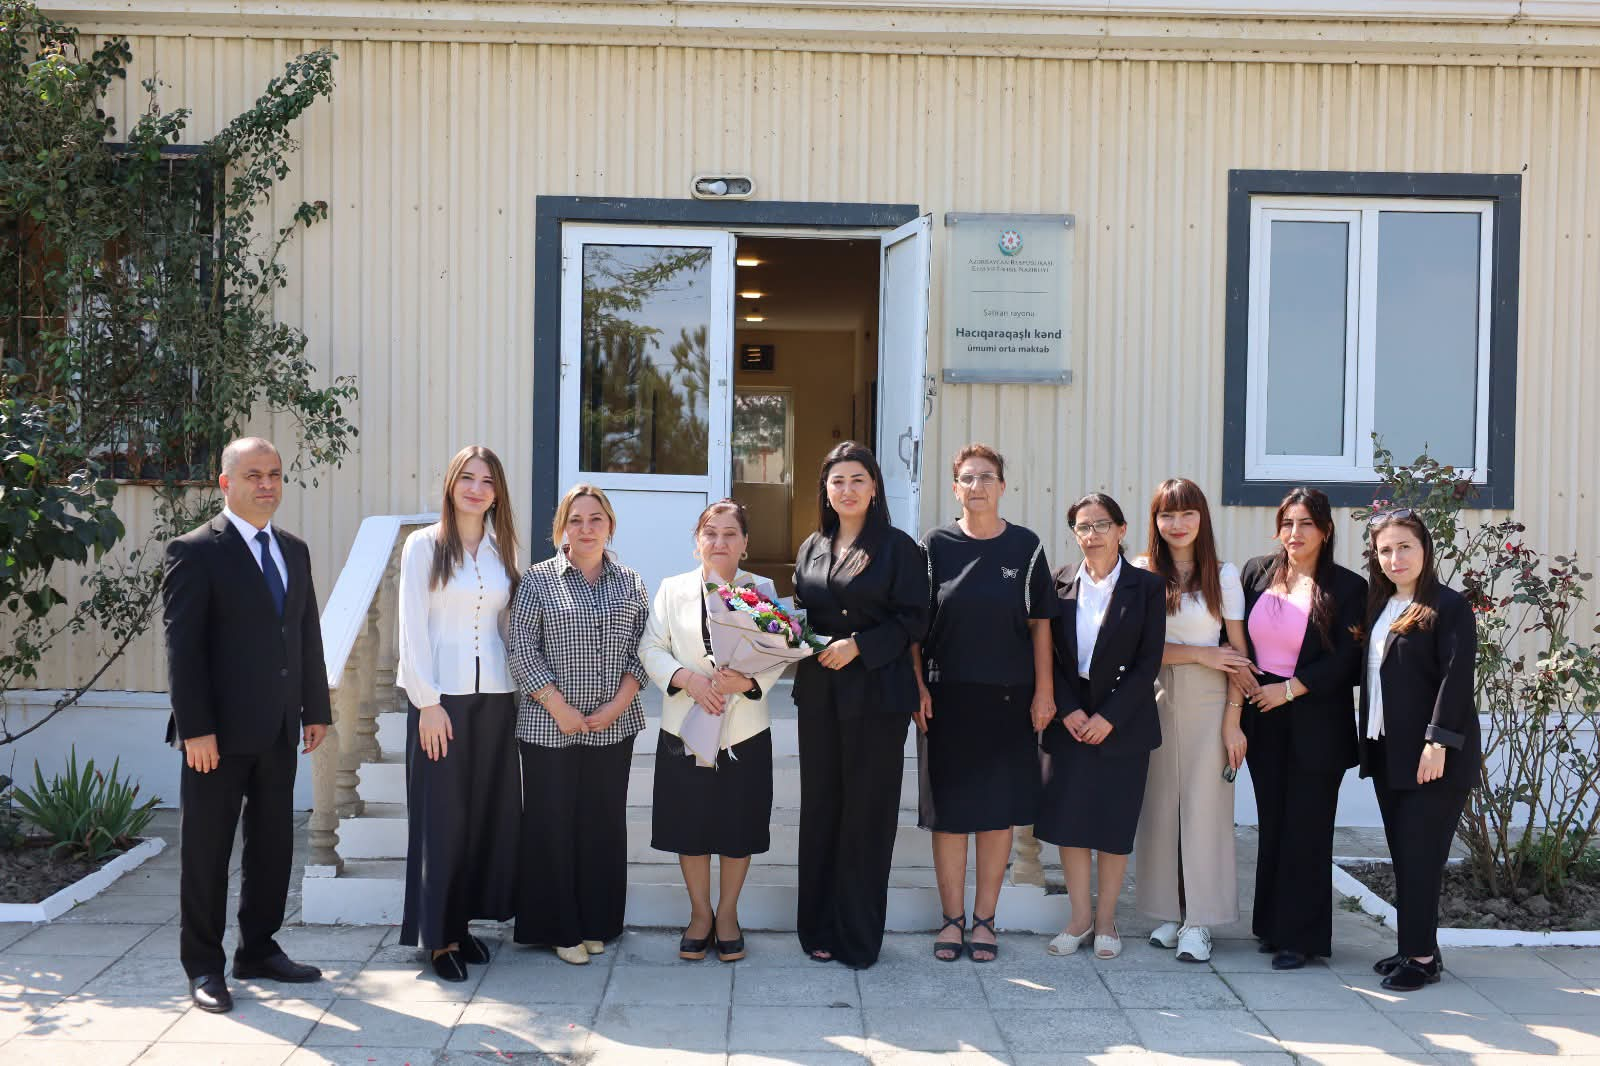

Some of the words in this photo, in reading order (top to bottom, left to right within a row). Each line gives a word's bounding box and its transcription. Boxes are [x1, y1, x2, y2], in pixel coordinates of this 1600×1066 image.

[955, 327, 1031, 341] Hacıqaraqaşlı
[1034, 328, 1062, 339] kənd
[998, 345, 1016, 353] orta
